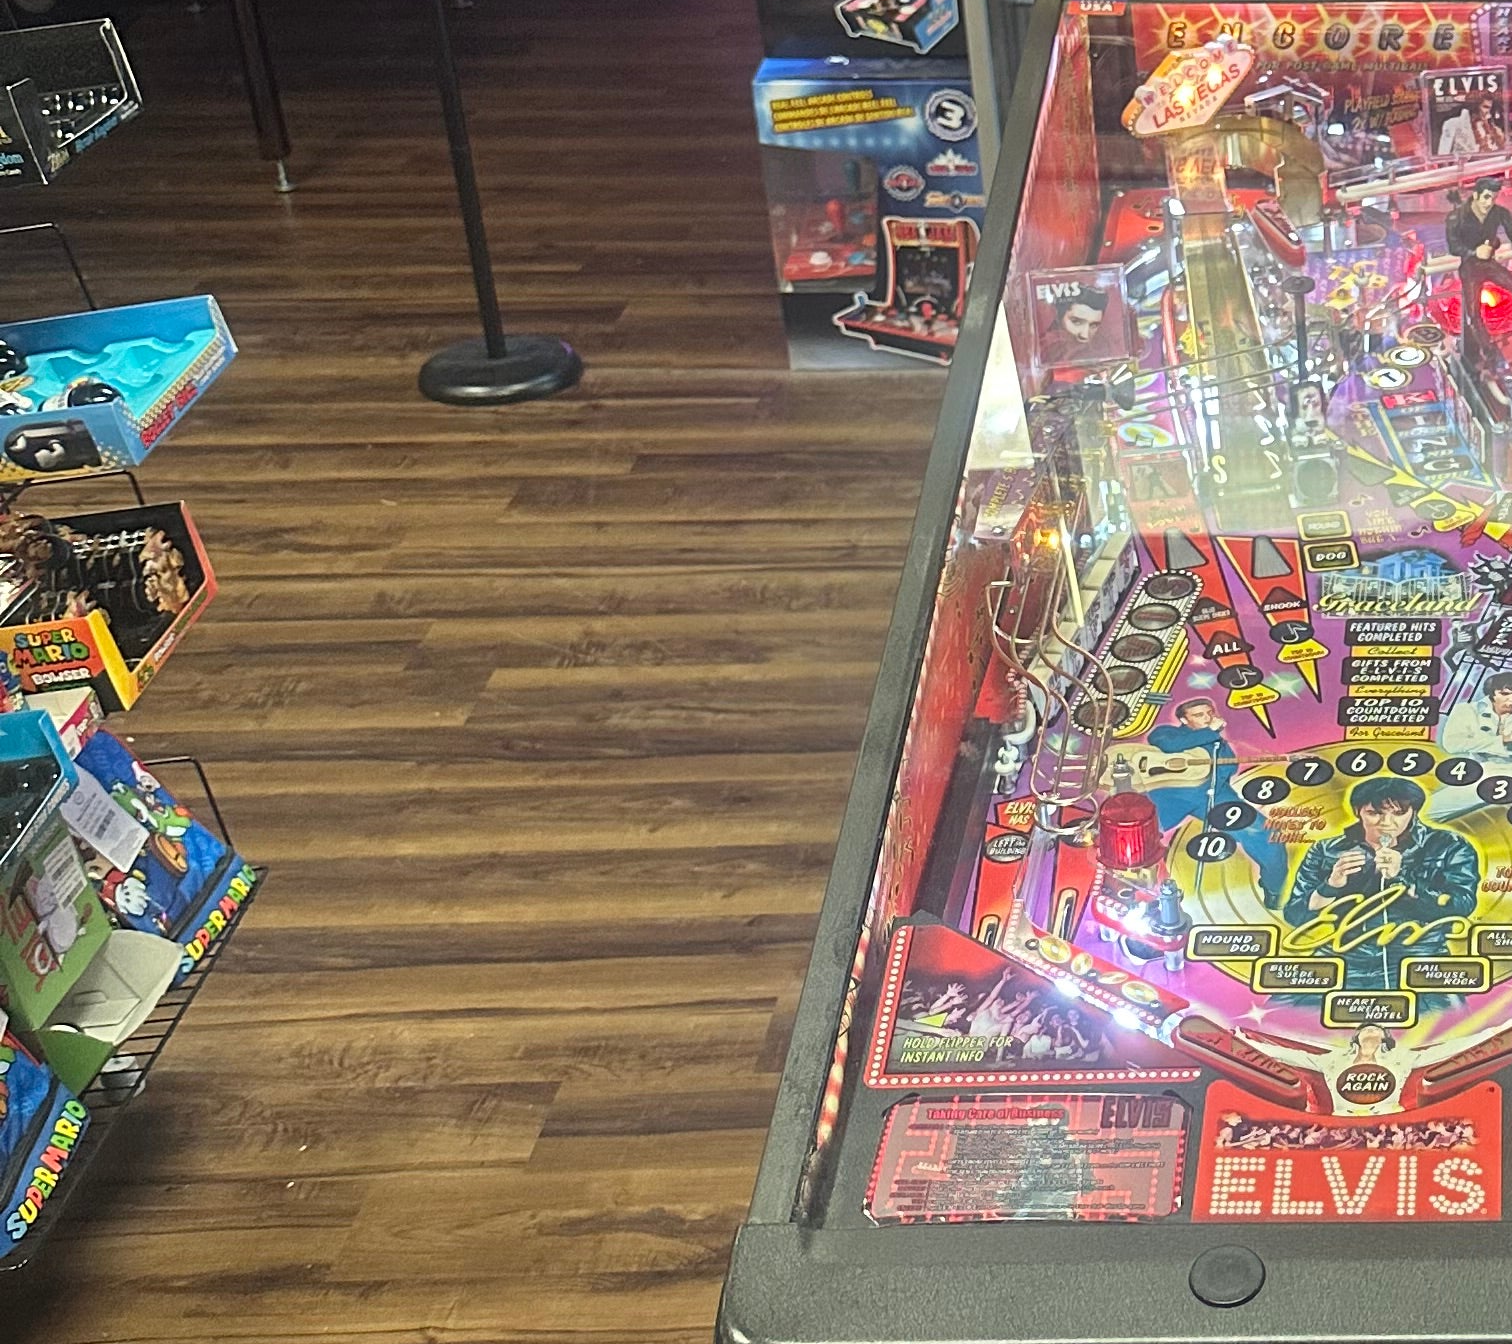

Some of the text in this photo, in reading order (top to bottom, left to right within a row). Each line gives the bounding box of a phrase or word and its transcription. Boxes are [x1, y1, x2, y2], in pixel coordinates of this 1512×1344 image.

[1080, 0, 1113, 13] USA
[1167, 20, 1455, 51] ENCORE
[1433, 76, 1499, 97] ELVIS
[940, 101, 965, 128] 3
[1152, 101, 1185, 129] LAS
[1036, 281, 1081, 301] ELVIS
[1314, 550, 1347, 563] DOG
[1263, 600, 1301, 612] SHOOK
[1312, 591, 1484, 616] Graceland
[1349, 621, 1436, 633] FEATURED HITS
[14, 628, 76, 649] SUPER
[1357, 632, 1423, 643] COMPLETED
[13, 642, 89, 665] MARIO
[1212, 641, 1241, 655] ALL
[1367, 646, 1418, 656] Collect
[1351, 659, 1432, 668] GIFTS FROM
[31, 667, 91, 685] BOWSER
[1350, 674, 1429, 684] COMPLETED
[1353, 699, 1423, 707] TOP 10
[1346, 706, 1430, 715] COUNTDOWN
[1350, 714, 1426, 724] COMPLETED
[1371, 727, 1426, 738] Graceland
[1350, 753, 1367, 772] 6
[1403, 753, 1419, 772] 5
[1304, 763, 1318, 781] 7
[1450, 762, 1466, 780] 4
[1258, 781, 1274, 800] 8
[1492, 781, 1508, 800] 3
[1008, 815, 1030, 825] HAS
[1225, 807, 1242, 827] 9
[1197, 837, 1226, 857] 10
[180, 863, 257, 974] SUPER MARIO
[1202, 934, 1253, 945] HOUND
[1487, 931, 1506, 940] ALL
[1230, 944, 1261, 953] DOG
[1270, 964, 1299, 972] BLUE
[1415, 964, 1440, 972] JAIL
[1277, 971, 1314, 979] SUEDE
[1290, 977, 1330, 985] SHOES
[1426, 971, 1467, 979] HOUSE
[1443, 977, 1478, 985] ROCK
[1337, 997, 1377, 1006] HEART
[1349, 1005, 1391, 1013] BREAK
[1365, 1011, 1403, 1020] HOTEL
[903, 1035, 1013, 1049] HOLD FLIPPER FOR
[900, 1049, 985, 1063] INSTANT INFO
[1346, 1072, 1387, 1082] ROCK
[1341, 1082, 1390, 1092] AGAIN
[1100, 1098, 1172, 1129] ELVIS
[6, 1099, 87, 1241] SUPER MARIO
[1209, 1155, 1486, 1217] ELVIS
